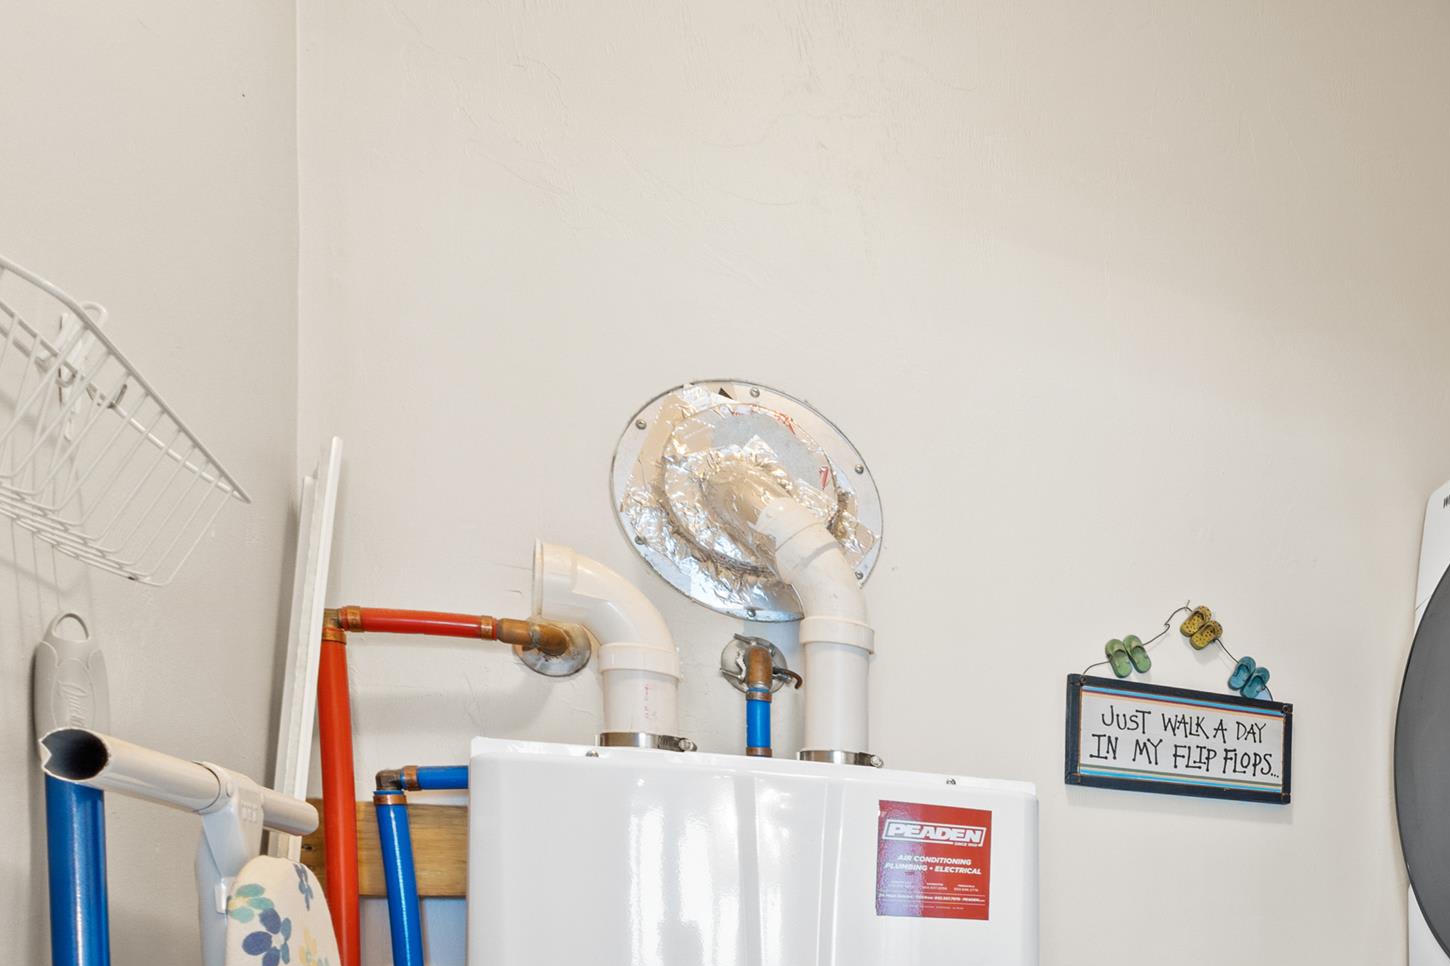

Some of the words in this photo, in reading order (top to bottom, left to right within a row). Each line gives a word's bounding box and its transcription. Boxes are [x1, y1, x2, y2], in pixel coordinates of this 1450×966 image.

[1100, 705, 1152, 735] JUST
[1161, 712, 1210, 740] WALK
[1213, 718, 1228, 744] A
[1236, 720, 1267, 744] DAY
[1089, 733, 1119, 761] IN
[1132, 738, 1163, 766] MY
[1173, 744, 1218, 772] FLIP
[887, 822, 982, 843] PEADEN
[884, 862, 928, 872] PLUMBING
[934, 865, 982, 876] ELECTRICAL
[897, 854, 913, 862] AIR
[914, 855, 972, 866] CONDITIONING
